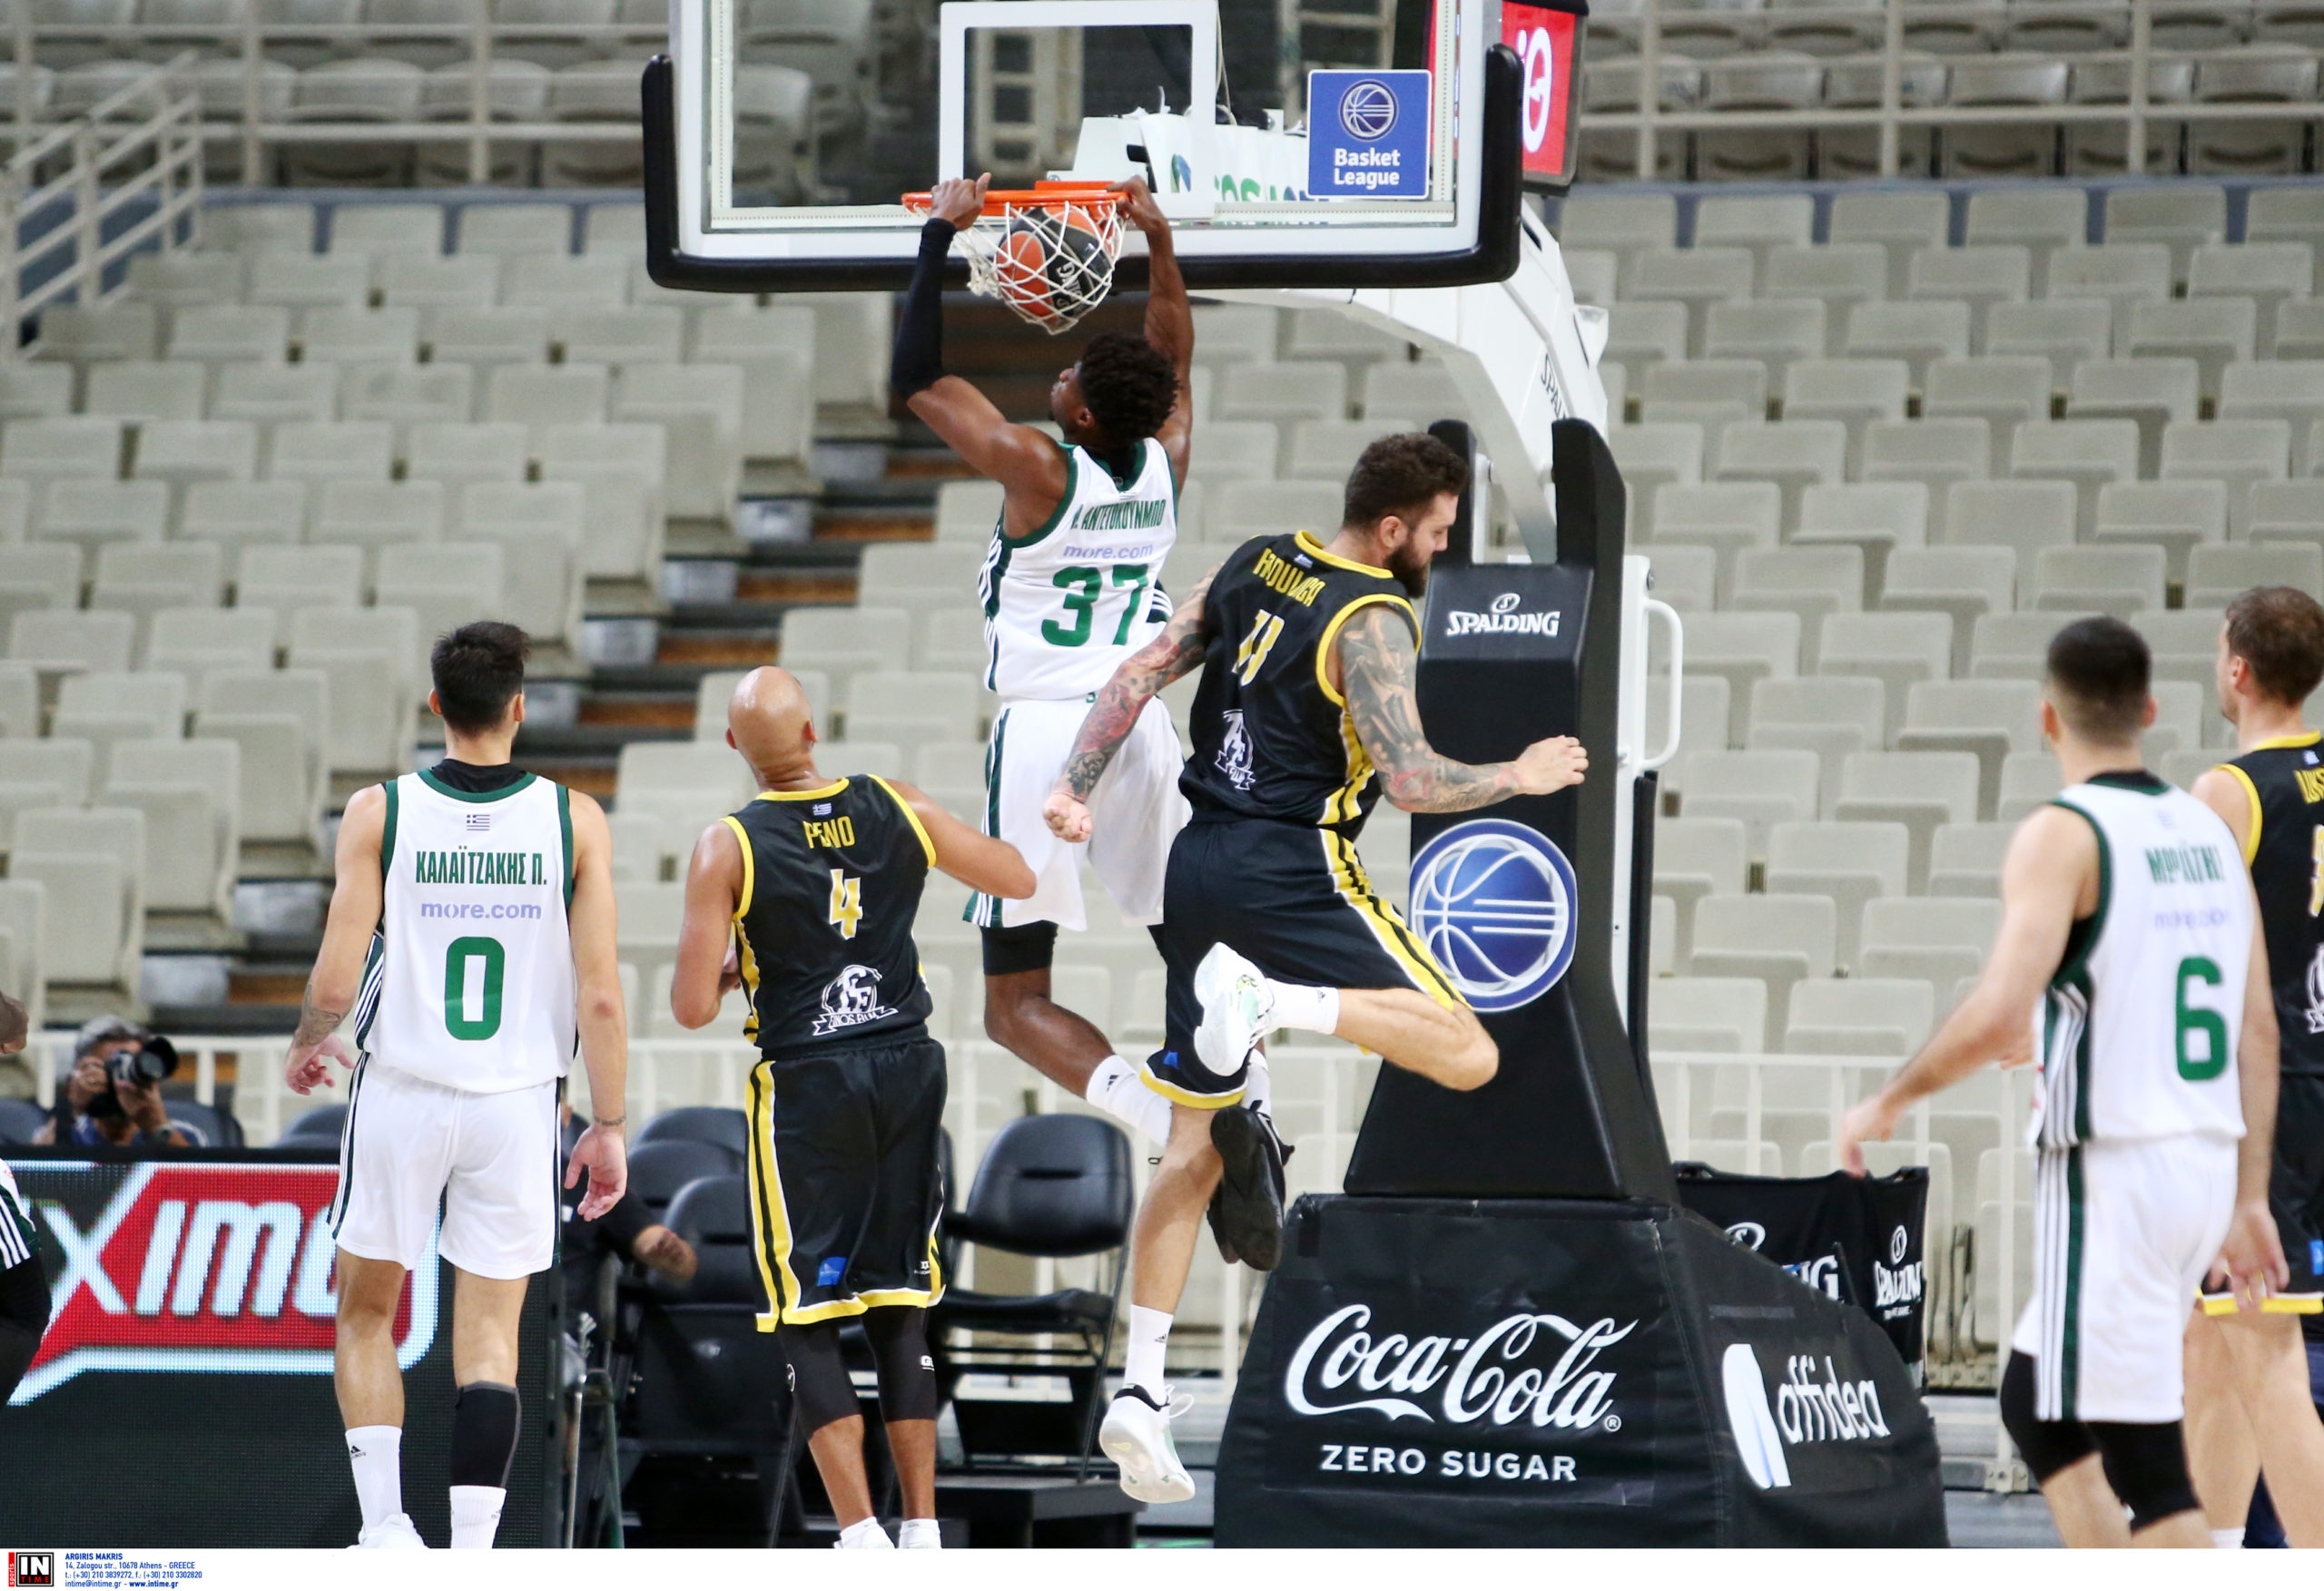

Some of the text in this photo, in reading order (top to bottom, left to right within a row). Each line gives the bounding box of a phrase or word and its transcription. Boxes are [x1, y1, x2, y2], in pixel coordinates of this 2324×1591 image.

[1333, 147, 1402, 170] Basket
[1333, 167, 1401, 192] League
[1541, 352, 1568, 420] SPAL
[1063, 544, 1154, 560] more.com
[1040, 563, 1149, 647] 37
[1445, 609, 1561, 638] SPALDING
[415, 845, 547, 886] ΚΑΛΑΪΤΖΑΚΗΣ Π.
[420, 901, 542, 919] more.com
[828, 868, 864, 940] 4
[444, 936, 505, 1041] 0
[2174, 955, 2228, 1082] 6
[1873, 1260, 1923, 1309] SPALDIN
[1283, 1302, 1640, 1431] Coca-Cola
[1777, 1353, 1892, 1446] affidea
[1320, 1444, 1578, 1482] ZERO SUGAR
